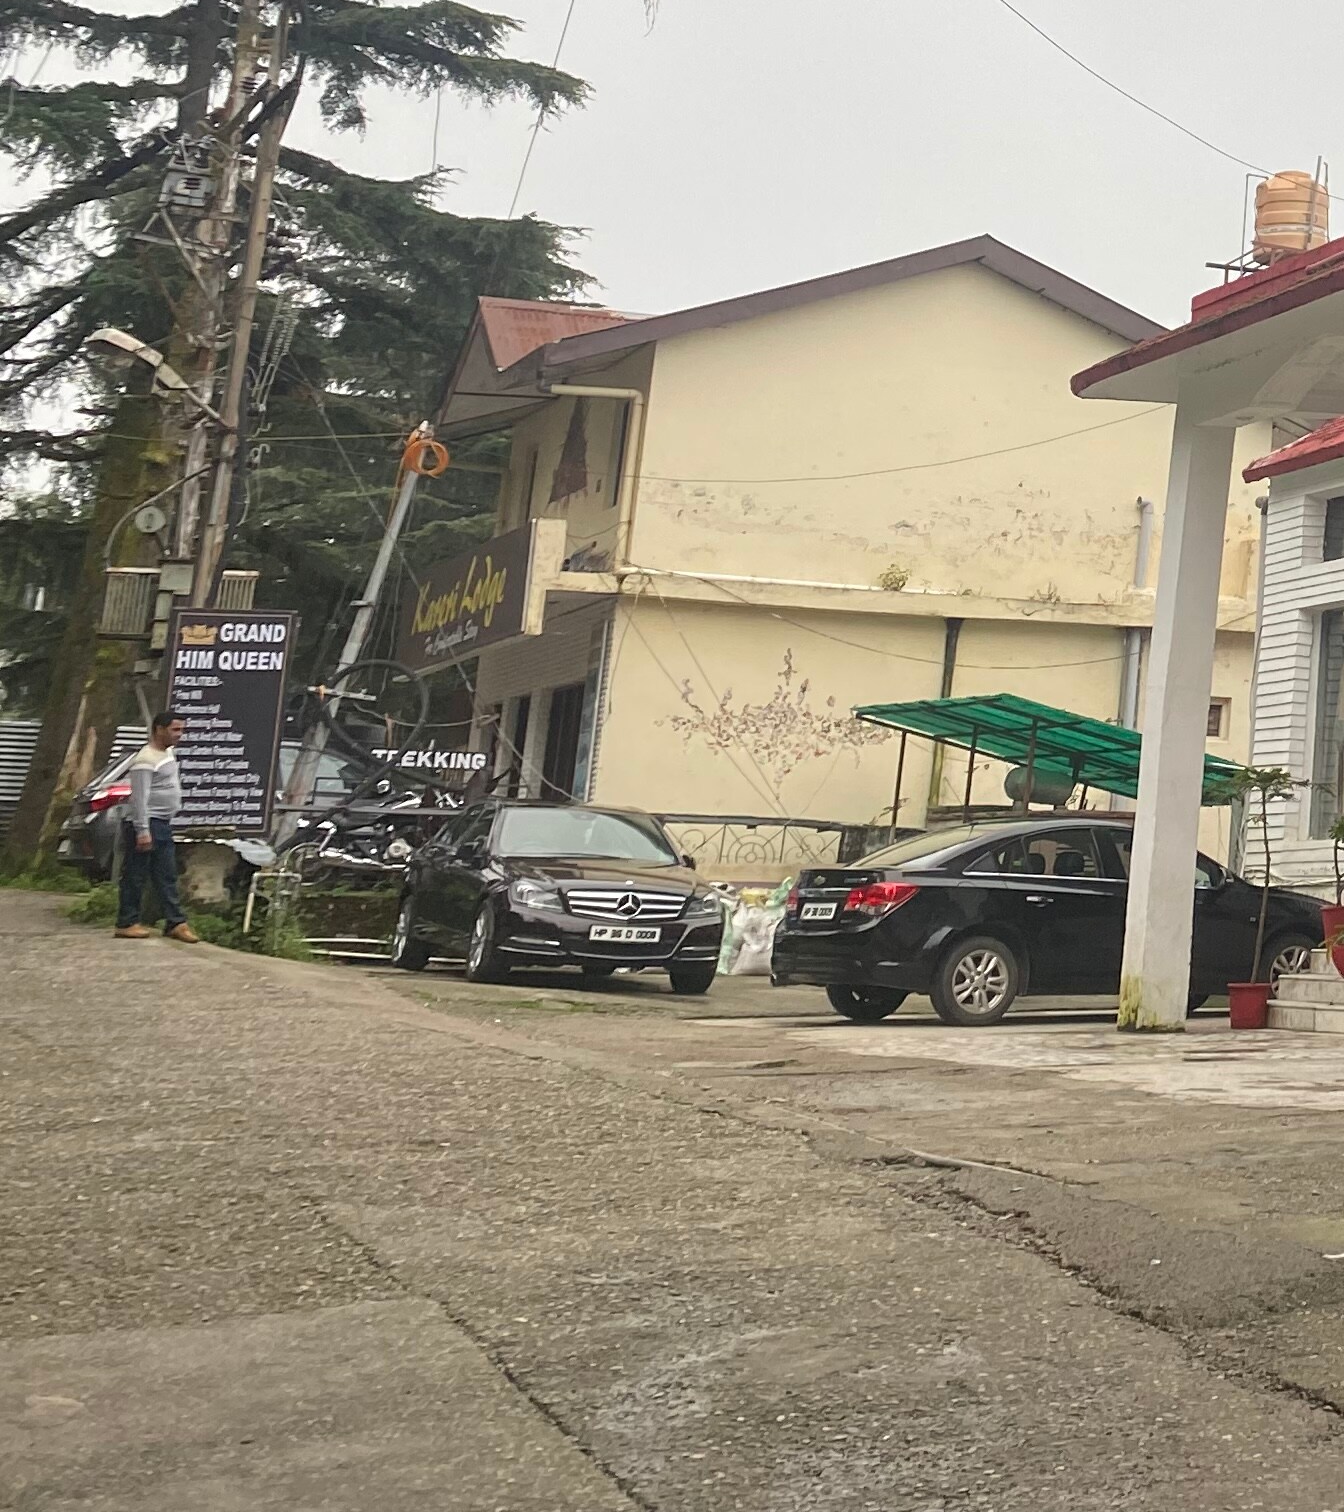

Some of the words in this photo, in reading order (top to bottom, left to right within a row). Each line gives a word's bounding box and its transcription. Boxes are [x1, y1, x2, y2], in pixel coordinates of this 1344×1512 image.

[457, 555, 507, 628] Lodge
[220, 622, 286, 643] GRAND
[176, 650, 215, 669] HIM
[218, 650, 284, 671] QUEEN
